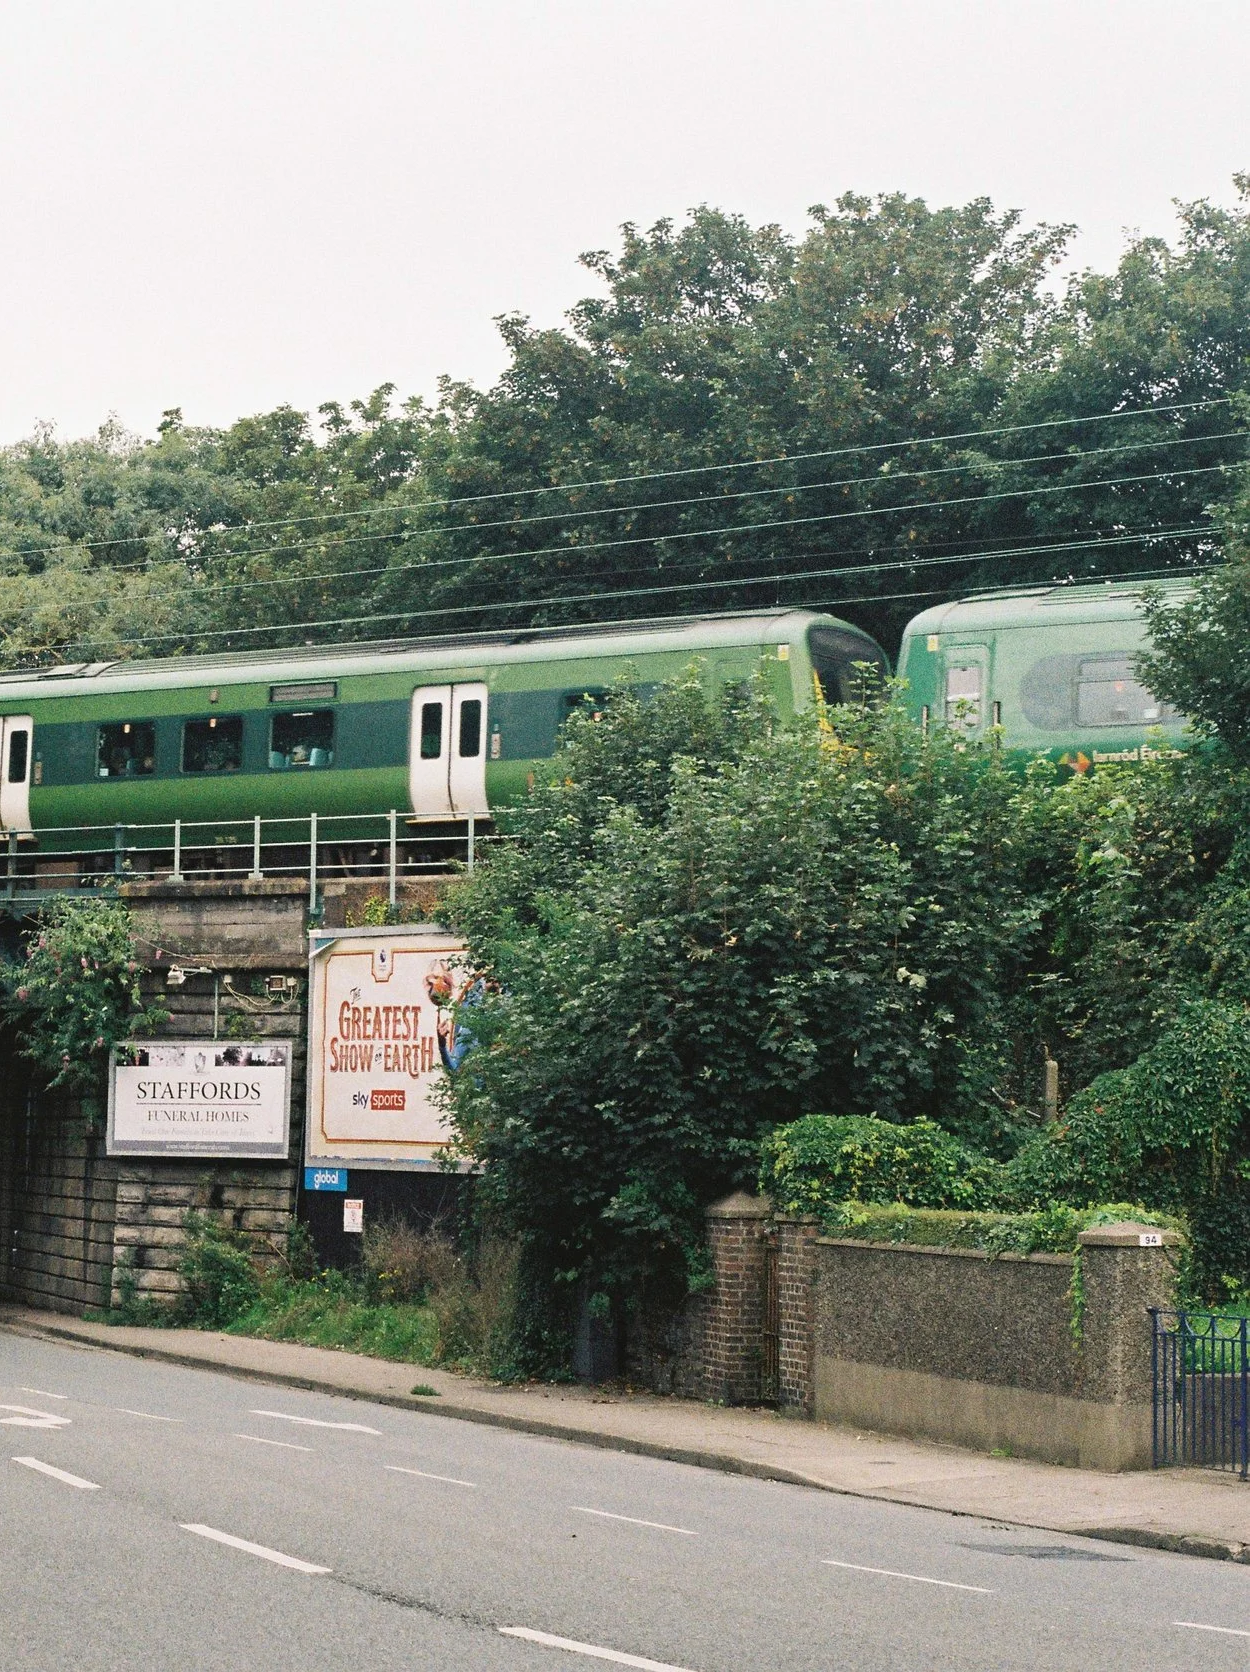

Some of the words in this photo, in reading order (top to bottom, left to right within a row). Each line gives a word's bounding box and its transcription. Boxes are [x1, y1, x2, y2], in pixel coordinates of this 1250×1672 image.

[338, 1000, 422, 1042] GREATEST
[330, 1036, 374, 1073] SHOW
[383, 1036, 435, 1080] EARTH
[136, 1081, 261, 1100] STAFFORDS
[352, 1091, 369, 1110] sky
[372, 1093, 404, 1110] sports
[147, 1110, 203, 1122] FUNERAL
[206, 1111, 250, 1123] HOMES
[314, 1169, 339, 1190] global
[1145, 1236, 1157, 1245] 94
